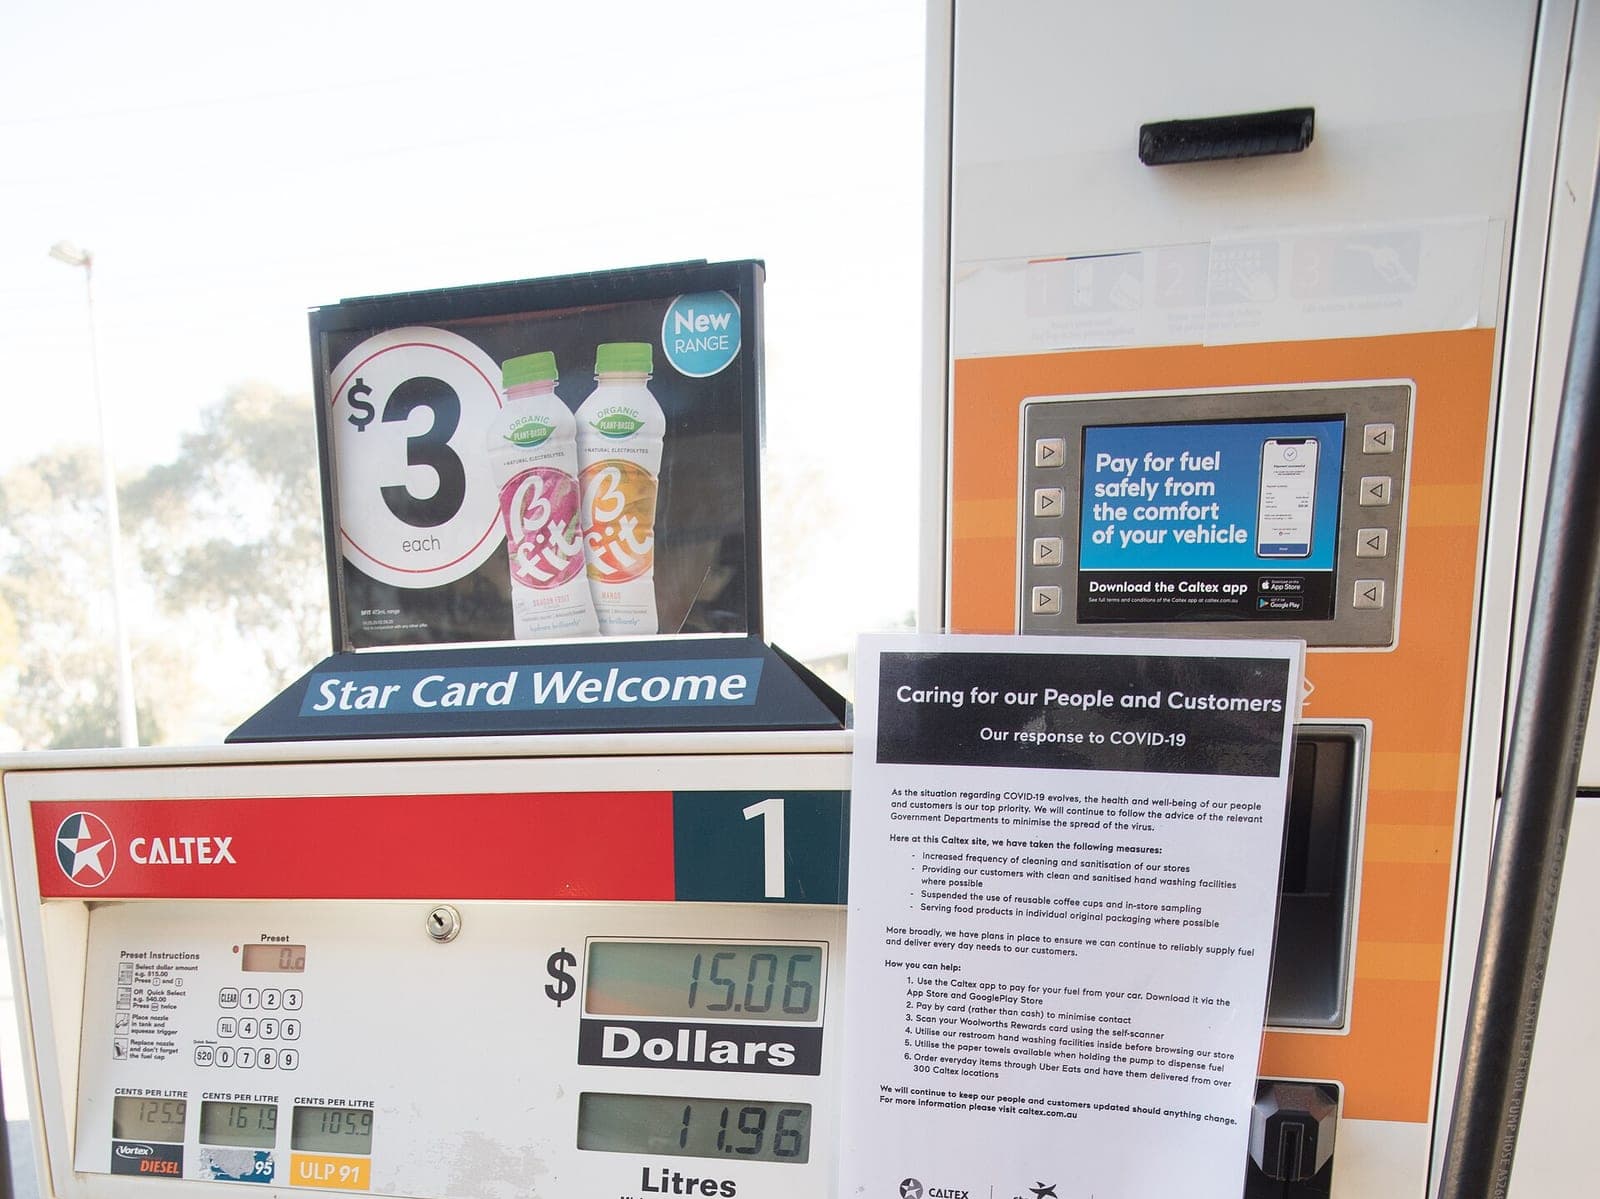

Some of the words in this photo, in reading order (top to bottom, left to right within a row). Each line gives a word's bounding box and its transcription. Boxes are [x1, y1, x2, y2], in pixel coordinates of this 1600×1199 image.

[675, 309, 731, 335] New
[675, 335, 728, 354] RANGE
[1096, 453, 1138, 477] Pay
[1143, 452, 1174, 471] for
[1180, 451, 1220, 471] fuel
[1094, 477, 1159, 500] safely
[1164, 477, 1215, 496] from
[1093, 502, 1127, 521] the
[1133, 501, 1219, 521] comfort
[402, 535, 440, 552] each
[1092, 525, 1114, 544] of
[1119, 530, 1168, 548] your
[1173, 524, 1247, 543] vehicle
[1090, 581, 1151, 592] Download
[1154, 581, 1175, 592] the
[1178, 581, 1219, 592] Caltex
[1222, 584, 1248, 595] app
[313, 679, 401, 711] Star
[412, 672, 518, 707] Card
[534, 668, 746, 704] Welcome
[897, 685, 964, 708] Caring
[970, 687, 999, 704] for
[1004, 692, 1038, 705] our
[1044, 688, 1114, 711] People
[1120, 691, 1161, 708] and
[1168, 692, 1282, 712] Customers
[980, 727, 1009, 740] Our
[1014, 732, 1083, 745] response
[1089, 732, 1104, 744] to
[1110, 731, 1186, 746] COVID-19
[130, 837, 236, 864] CALTEX
[743, 798, 785, 898] 1
[890, 834, 909, 842] Here
[923, 835, 939, 843] this
[941, 836, 969, 844] Caltex
[972, 837, 989, 847] site,
[1006, 839, 1027, 847] have
[1030, 840, 1054, 848] taken
[1057, 841, 1070, 849] the
[1073, 842, 1113, 853] following
[1116, 846, 1162, 854] measures:
[261, 934, 289, 942] Preset
[905, 962, 920, 970] you
[940, 963, 961, 973] help:
[544, 947, 577, 1008] $
[689, 952, 813, 1014] 15.06
[602, 1026, 795, 1066] Dollars
[115, 1088, 143, 1097] CENTS
[164, 1090, 188, 1098] LITRE
[202, 1092, 231, 1102] CENTS
[254, 1095, 279, 1103] LITRE
[294, 1097, 325, 1105] CENTS
[328, 1098, 345, 1106] PER
[348, 1100, 374, 1108] LITRE
[918, 1098, 966, 1109] information
[969, 1103, 996, 1112] please
[998, 1105, 1016, 1114] visit
[1018, 1108, 1077, 1119] caltex.com.au
[321, 1110, 371, 1136] 105.9
[679, 1105, 803, 1158] 11.96
[119, 1145, 150, 1156] Vortex
[140, 1160, 179, 1174] DIESEL
[254, 1160, 273, 1176] 95
[300, 1162, 335, 1180] ULP
[339, 1165, 359, 1182] 91
[642, 1167, 736, 1198] Litres
[929, 1188, 969, 1199] CALTEX
